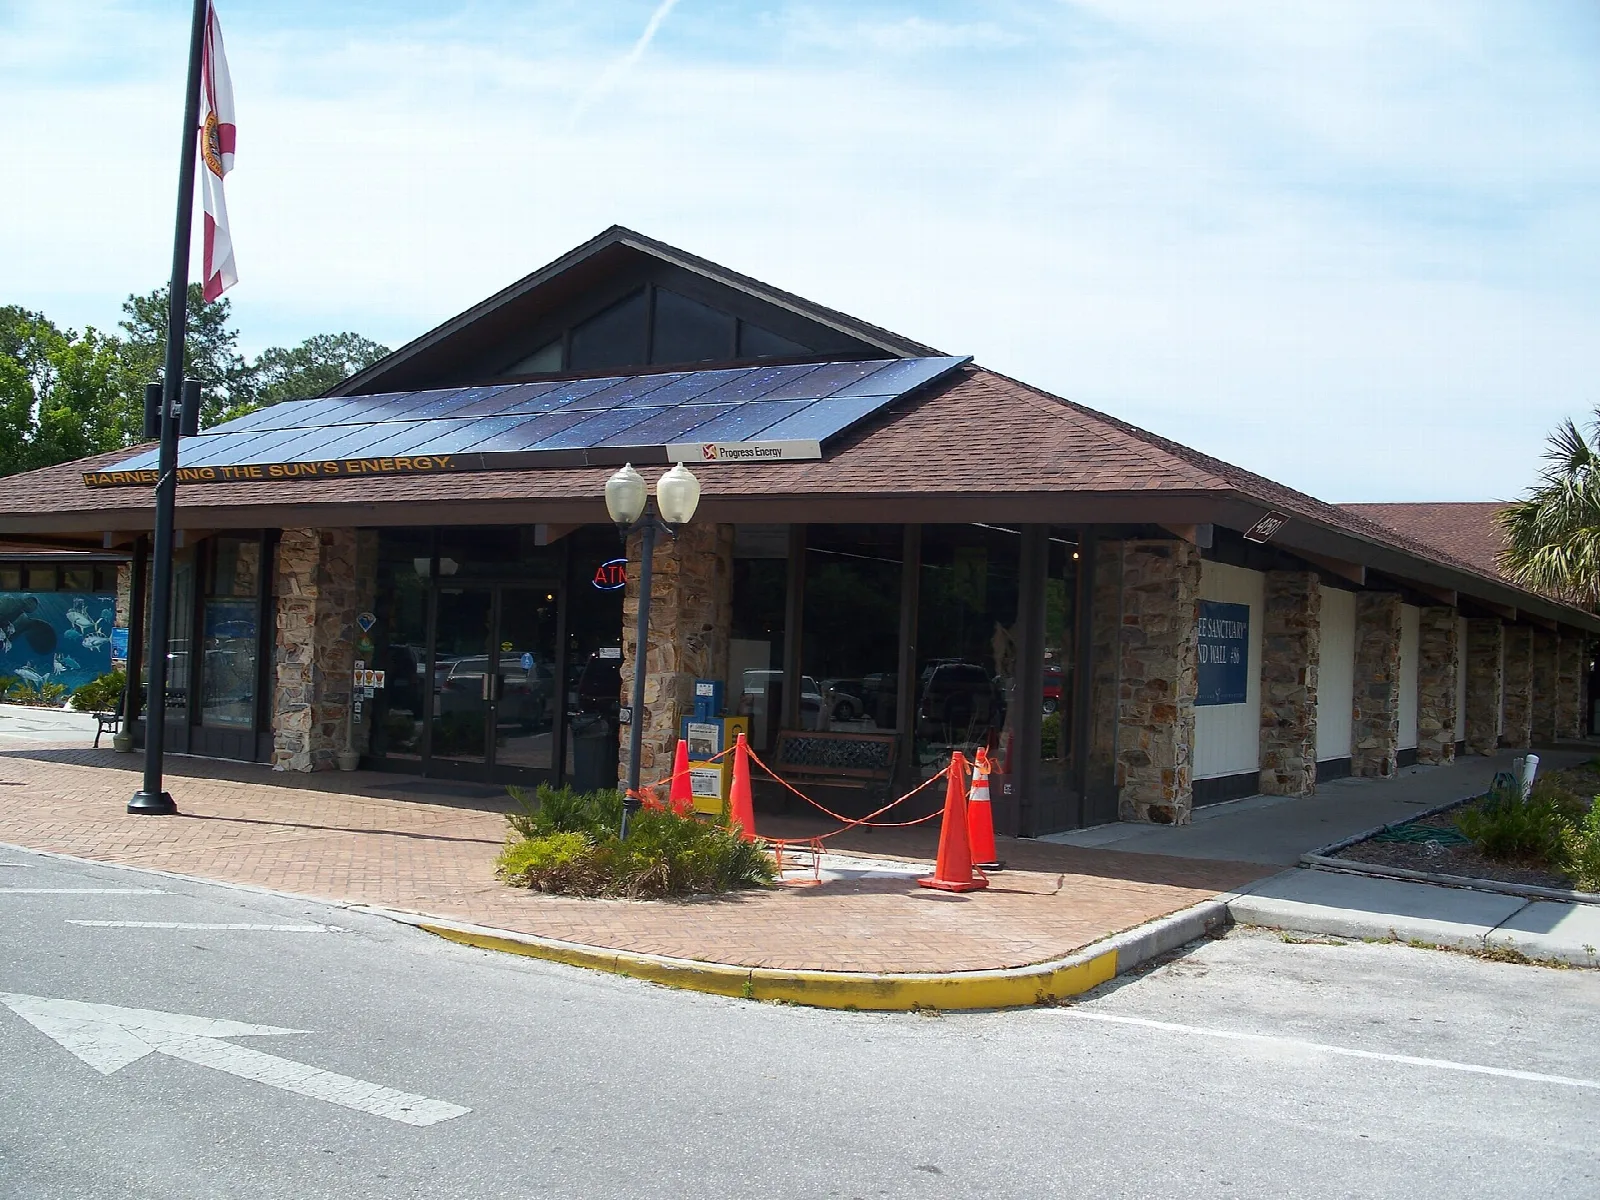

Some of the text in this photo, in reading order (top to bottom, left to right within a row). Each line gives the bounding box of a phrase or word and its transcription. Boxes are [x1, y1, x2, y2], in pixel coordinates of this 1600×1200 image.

[720, 446, 782, 460] Progress Energy
[83, 456, 455, 485] HARNEING THE SUN'S ENERGY.
[1210, 645, 1227, 664] WALL
